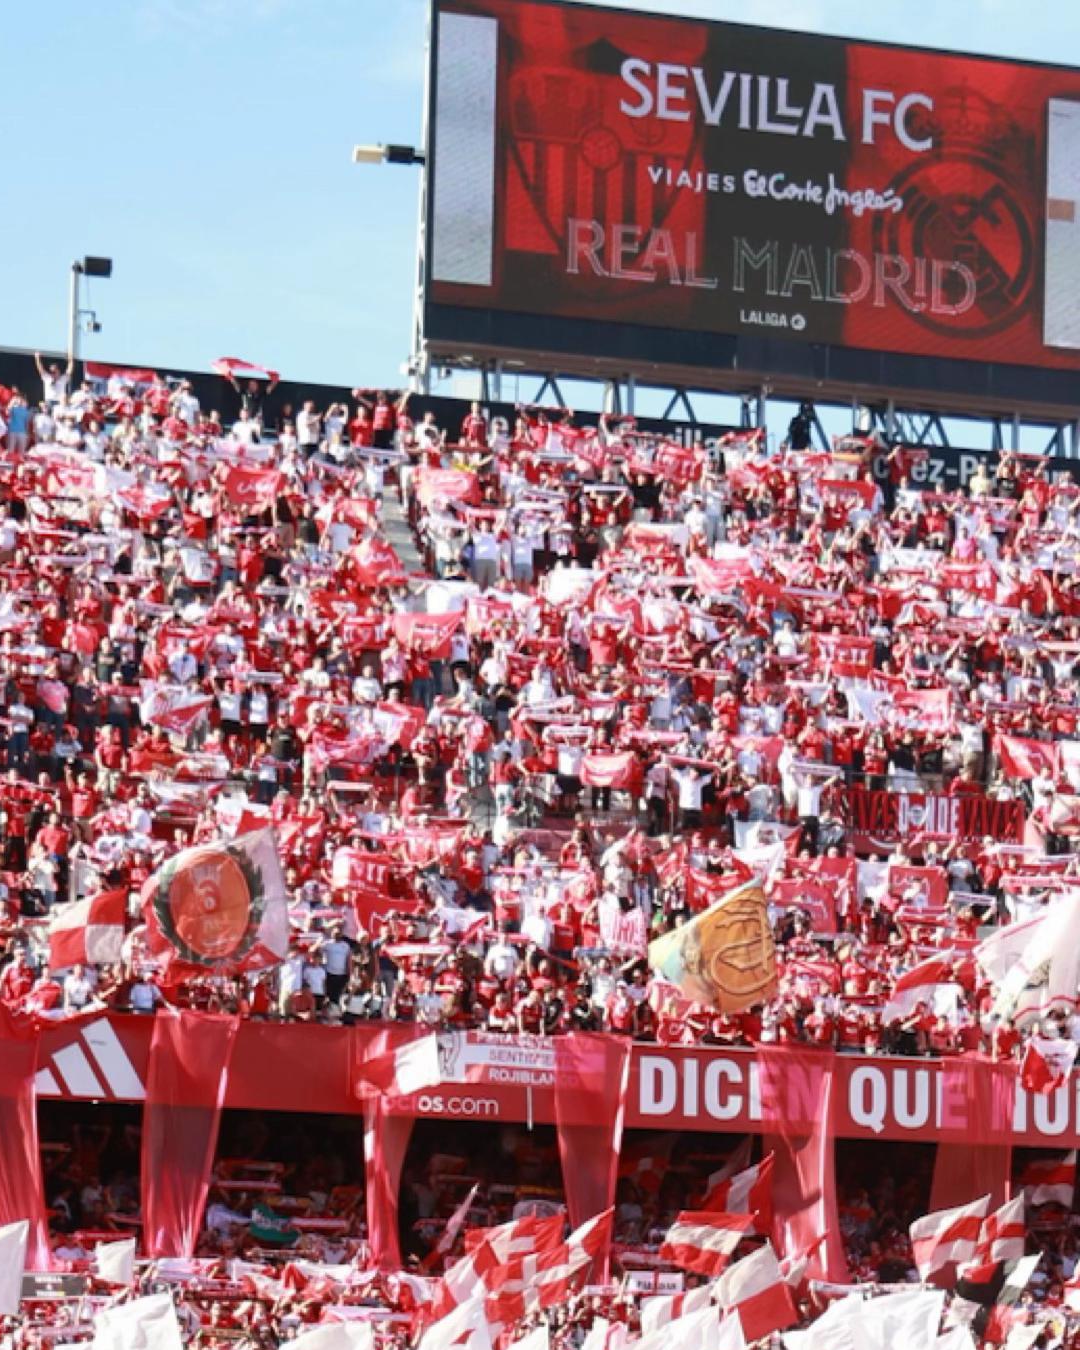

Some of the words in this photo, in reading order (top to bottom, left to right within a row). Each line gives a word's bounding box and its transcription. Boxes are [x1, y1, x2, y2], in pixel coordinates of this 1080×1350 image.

[620, 57, 847, 142] SEVILLA
[862, 88, 934, 152] FC
[647, 166, 736, 193] VIAJES
[566, 217, 719, 290] REAL
[731, 235, 978, 316] MADRID
[739, 309, 789, 328] LALIGA
[848, 1066, 968, 1134] QUE
